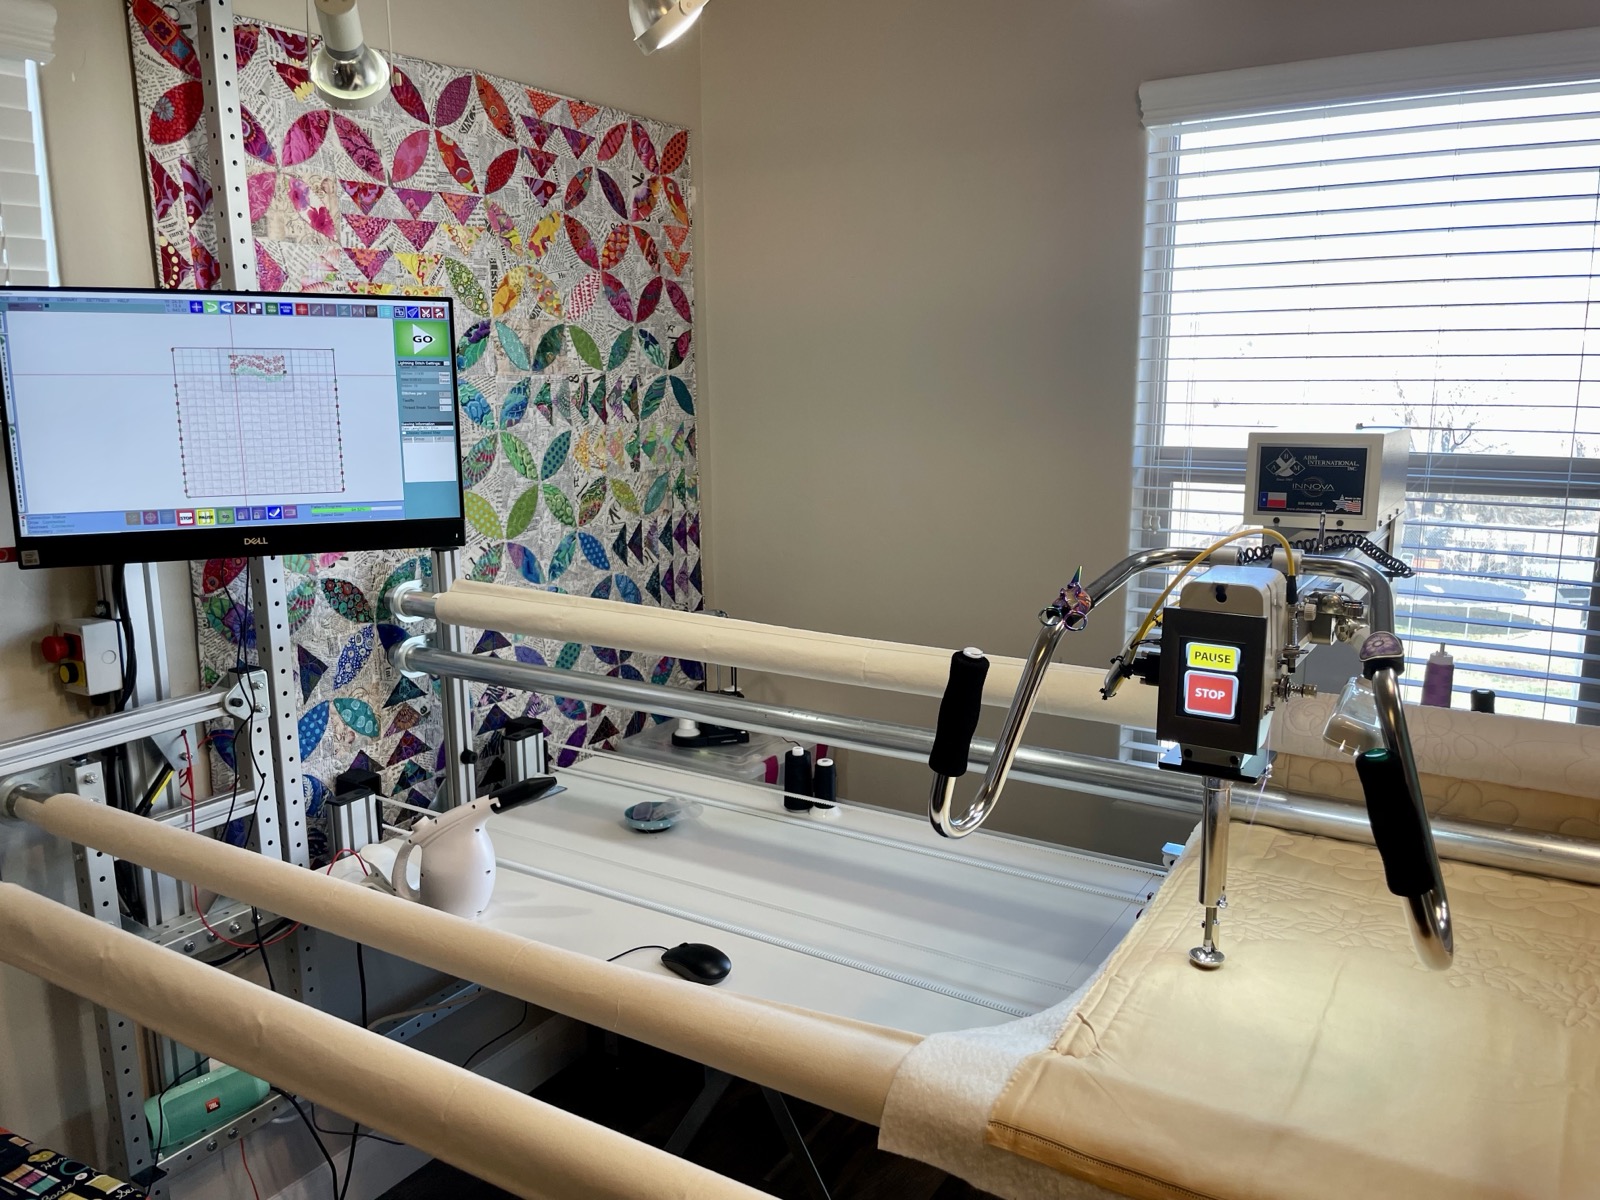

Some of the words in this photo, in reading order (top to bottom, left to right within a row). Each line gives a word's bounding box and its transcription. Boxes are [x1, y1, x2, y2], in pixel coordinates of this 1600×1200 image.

[412, 335, 433, 343] GO
[244, 537, 268, 545] DELL
[1194, 651, 1231, 664] PAUSE
[1195, 687, 1226, 700] STOP
